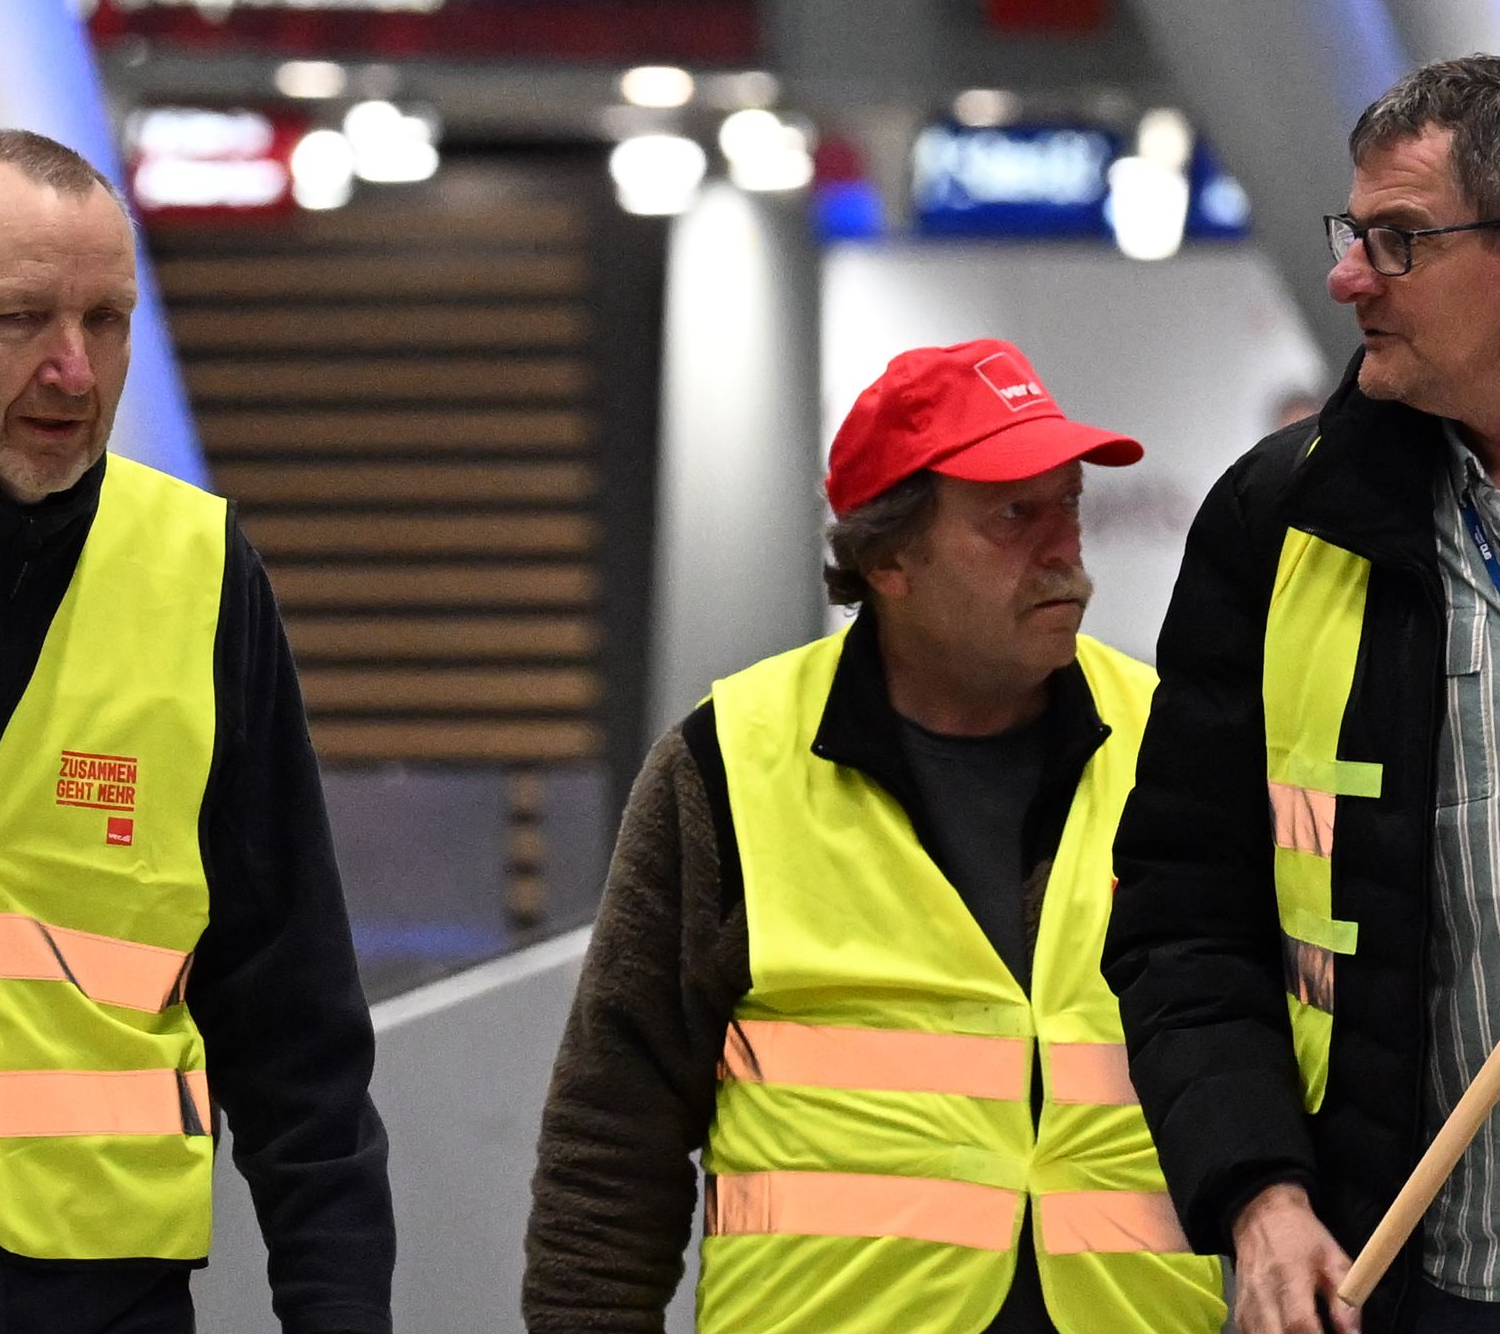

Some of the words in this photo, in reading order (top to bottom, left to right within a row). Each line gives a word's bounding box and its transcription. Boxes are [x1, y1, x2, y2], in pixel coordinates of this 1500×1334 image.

[59, 757, 137, 784] ZUSAMMEN
[56, 778, 94, 801] GEHT
[97, 783, 136, 805] MEHR
